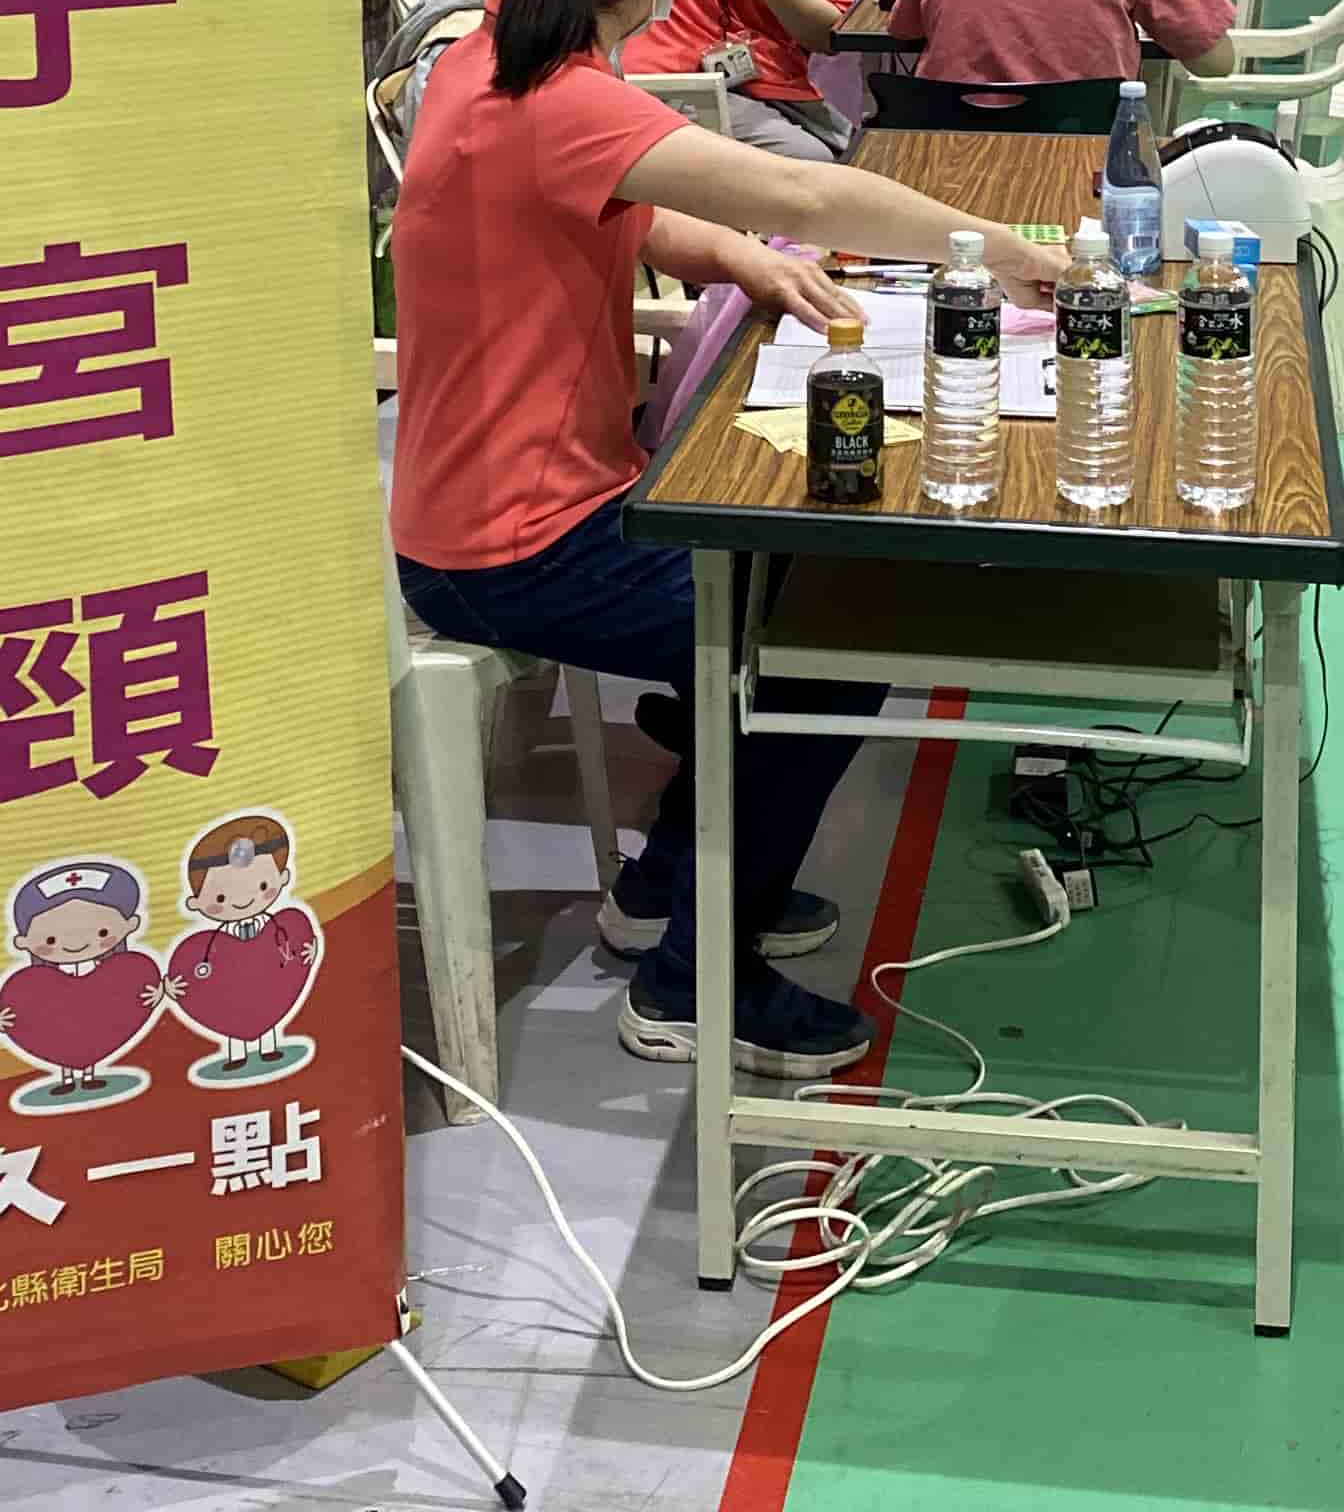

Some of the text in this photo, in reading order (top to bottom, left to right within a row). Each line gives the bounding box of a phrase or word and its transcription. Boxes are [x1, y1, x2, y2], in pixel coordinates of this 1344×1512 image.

[835, 436, 870, 449] BLACK
[215, 1220, 336, 1270] 關心您
